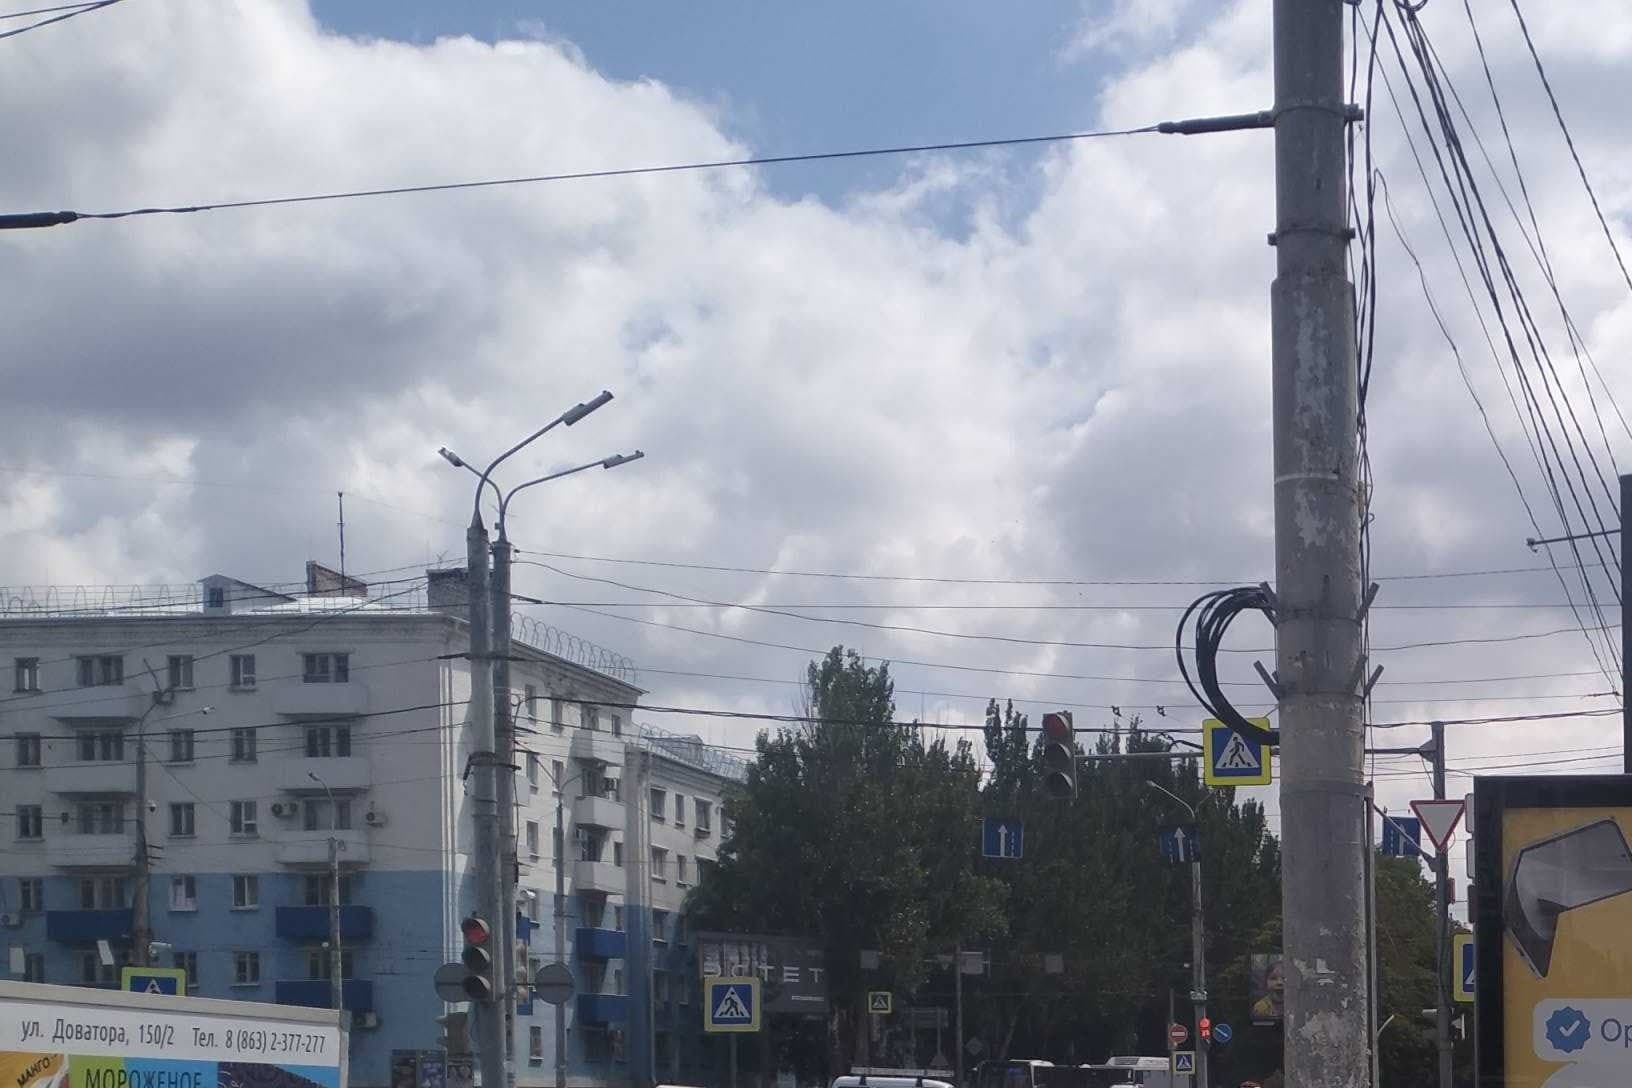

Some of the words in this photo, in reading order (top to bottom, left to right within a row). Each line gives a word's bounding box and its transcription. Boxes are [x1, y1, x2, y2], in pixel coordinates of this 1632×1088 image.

[20, 1019, 44, 1042] ул.
[52, 1018, 129, 1046] Доватора,
[138, 1023, 175, 1049] 150/2
[192, 1027, 218, 1048] Тел.
[225, 1029, 232, 1049] 8
[236, 1029, 267, 1053] (863)
[270, 1033, 326, 1054] 2-377-277
[17, 1057, 50, 1088] МАНГО
